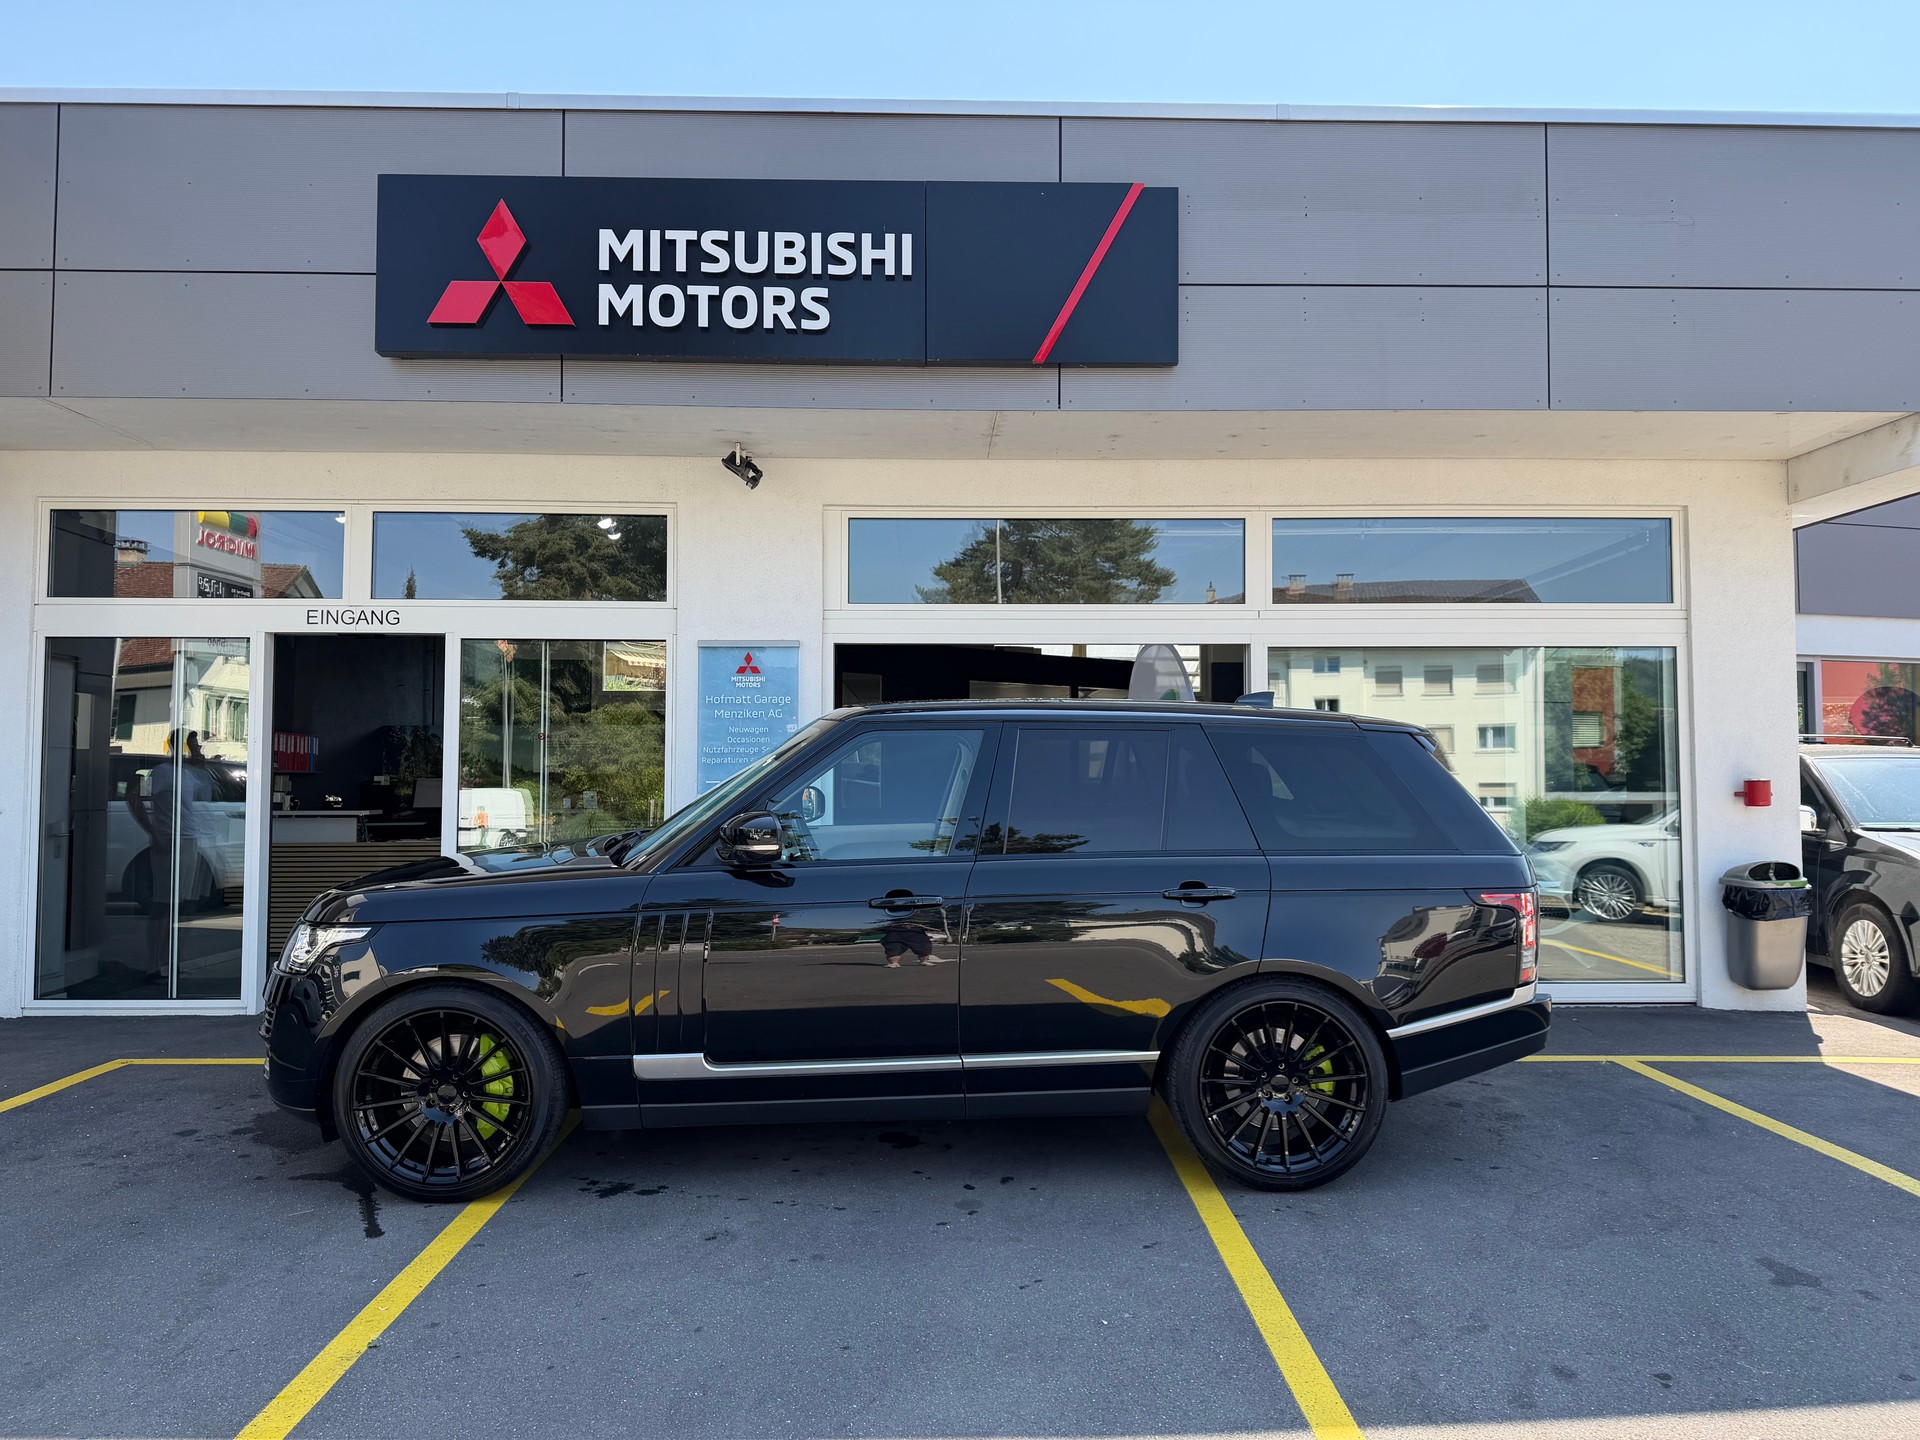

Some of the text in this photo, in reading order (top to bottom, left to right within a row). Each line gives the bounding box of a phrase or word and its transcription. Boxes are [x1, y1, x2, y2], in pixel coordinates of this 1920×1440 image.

[597, 228, 914, 277] MITSUBISHI
[597, 283, 831, 332] MOTORS
[306, 609, 400, 626] EINGANG
[705, 694, 792, 706] Hofmatt Garage
[714, 708, 783, 719] Menziken AG
[728, 726, 769, 735] Neuwagen
[703, 746, 759, 755] Nutzfahrzeuge
[701, 756, 749, 766] Reparaturen
